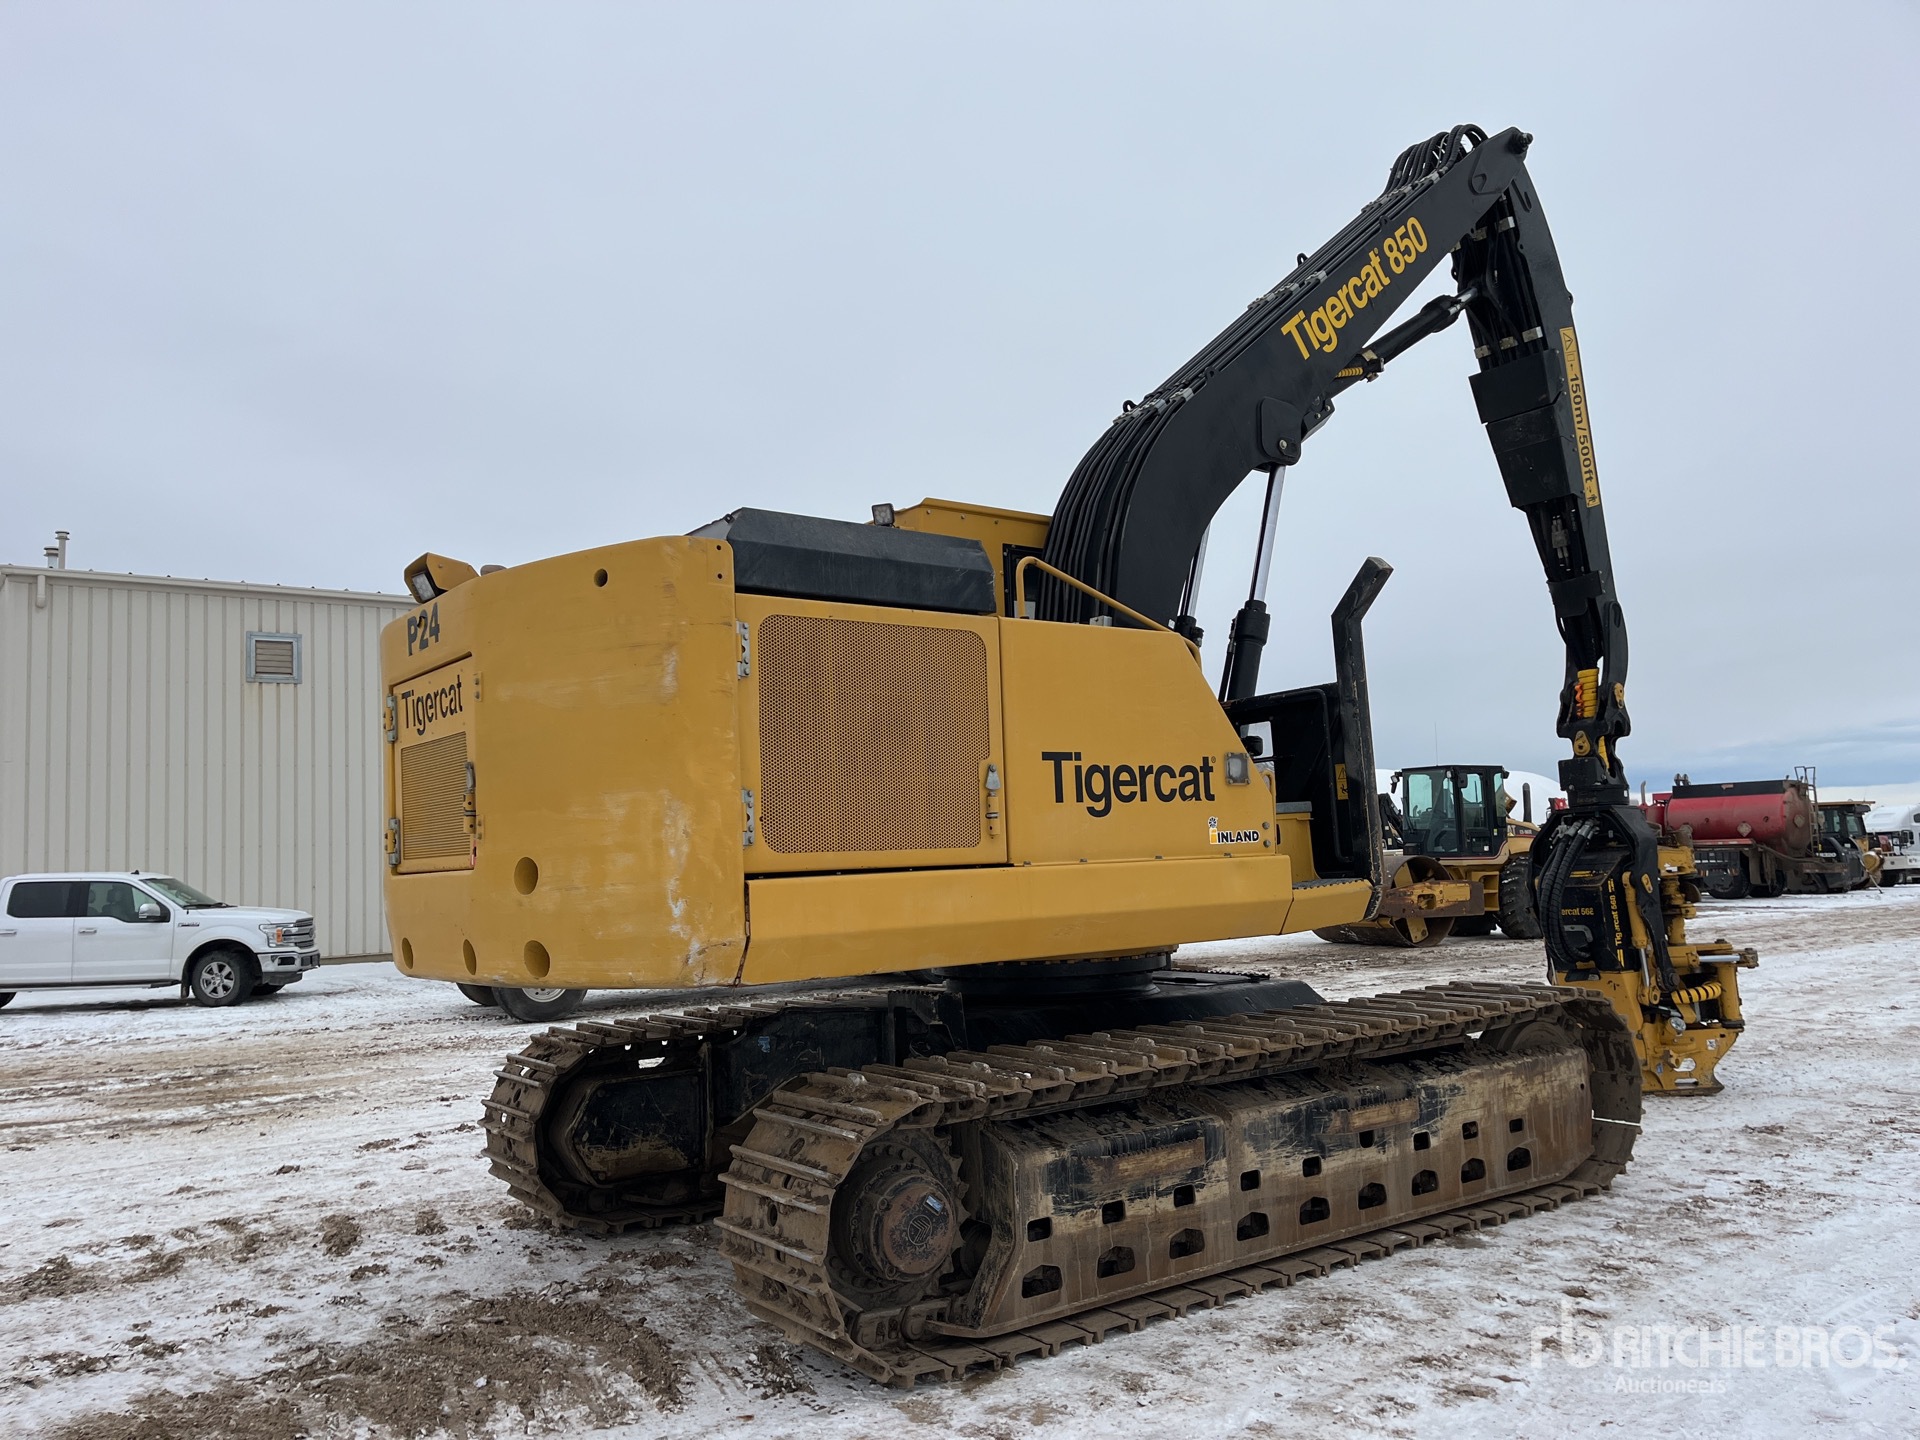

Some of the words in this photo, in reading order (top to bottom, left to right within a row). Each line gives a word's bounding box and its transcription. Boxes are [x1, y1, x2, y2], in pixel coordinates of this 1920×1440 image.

[1280, 250, 1391, 360] Tigercat
[1383, 216, 1428, 274] 850
[407, 602, 440, 657] P24
[401, 674, 463, 736] Tigercat
[1041, 751, 1216, 818] Tigercat
[1561, 907, 1580, 916] ercat
